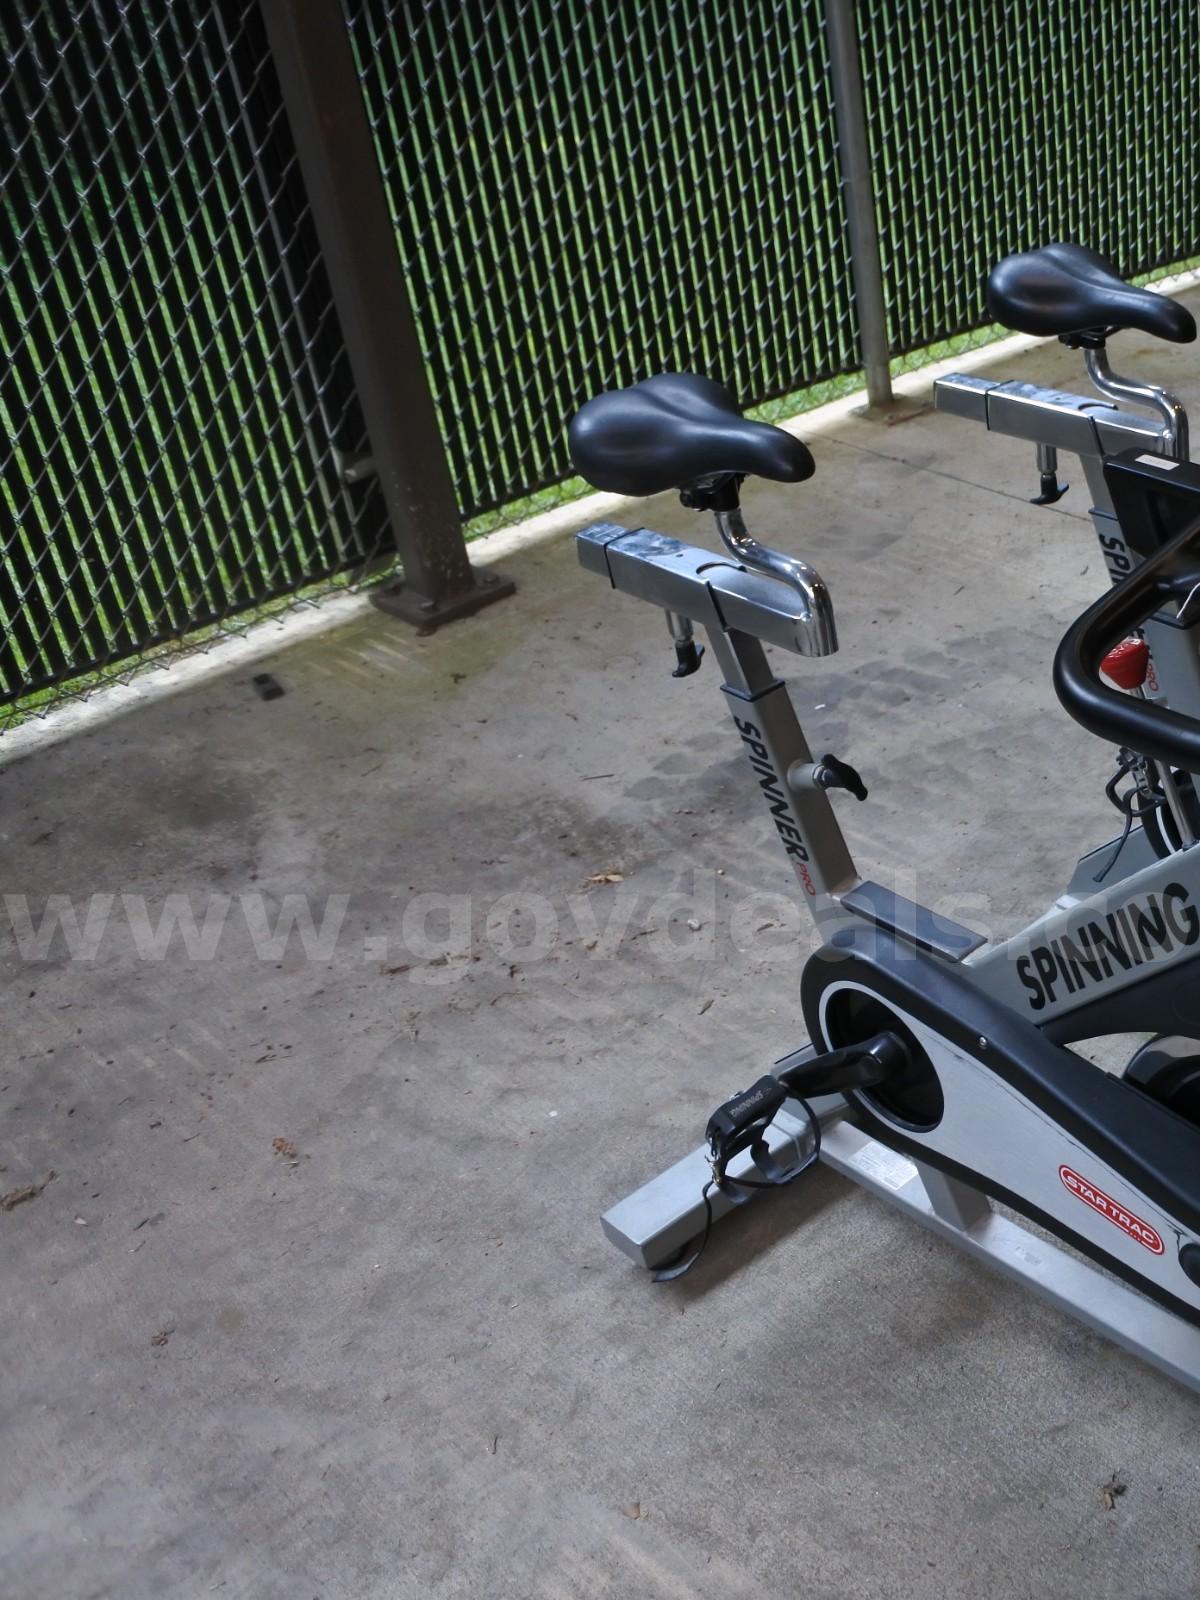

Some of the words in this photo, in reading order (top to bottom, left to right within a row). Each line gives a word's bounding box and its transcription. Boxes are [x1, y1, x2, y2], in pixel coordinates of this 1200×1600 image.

[734, 715, 810, 862] SPINNER
[797, 862, 817, 897] PRO
[1062, 1175, 1107, 1210] STAR
[1109, 1205, 1155, 1244] TRAC
